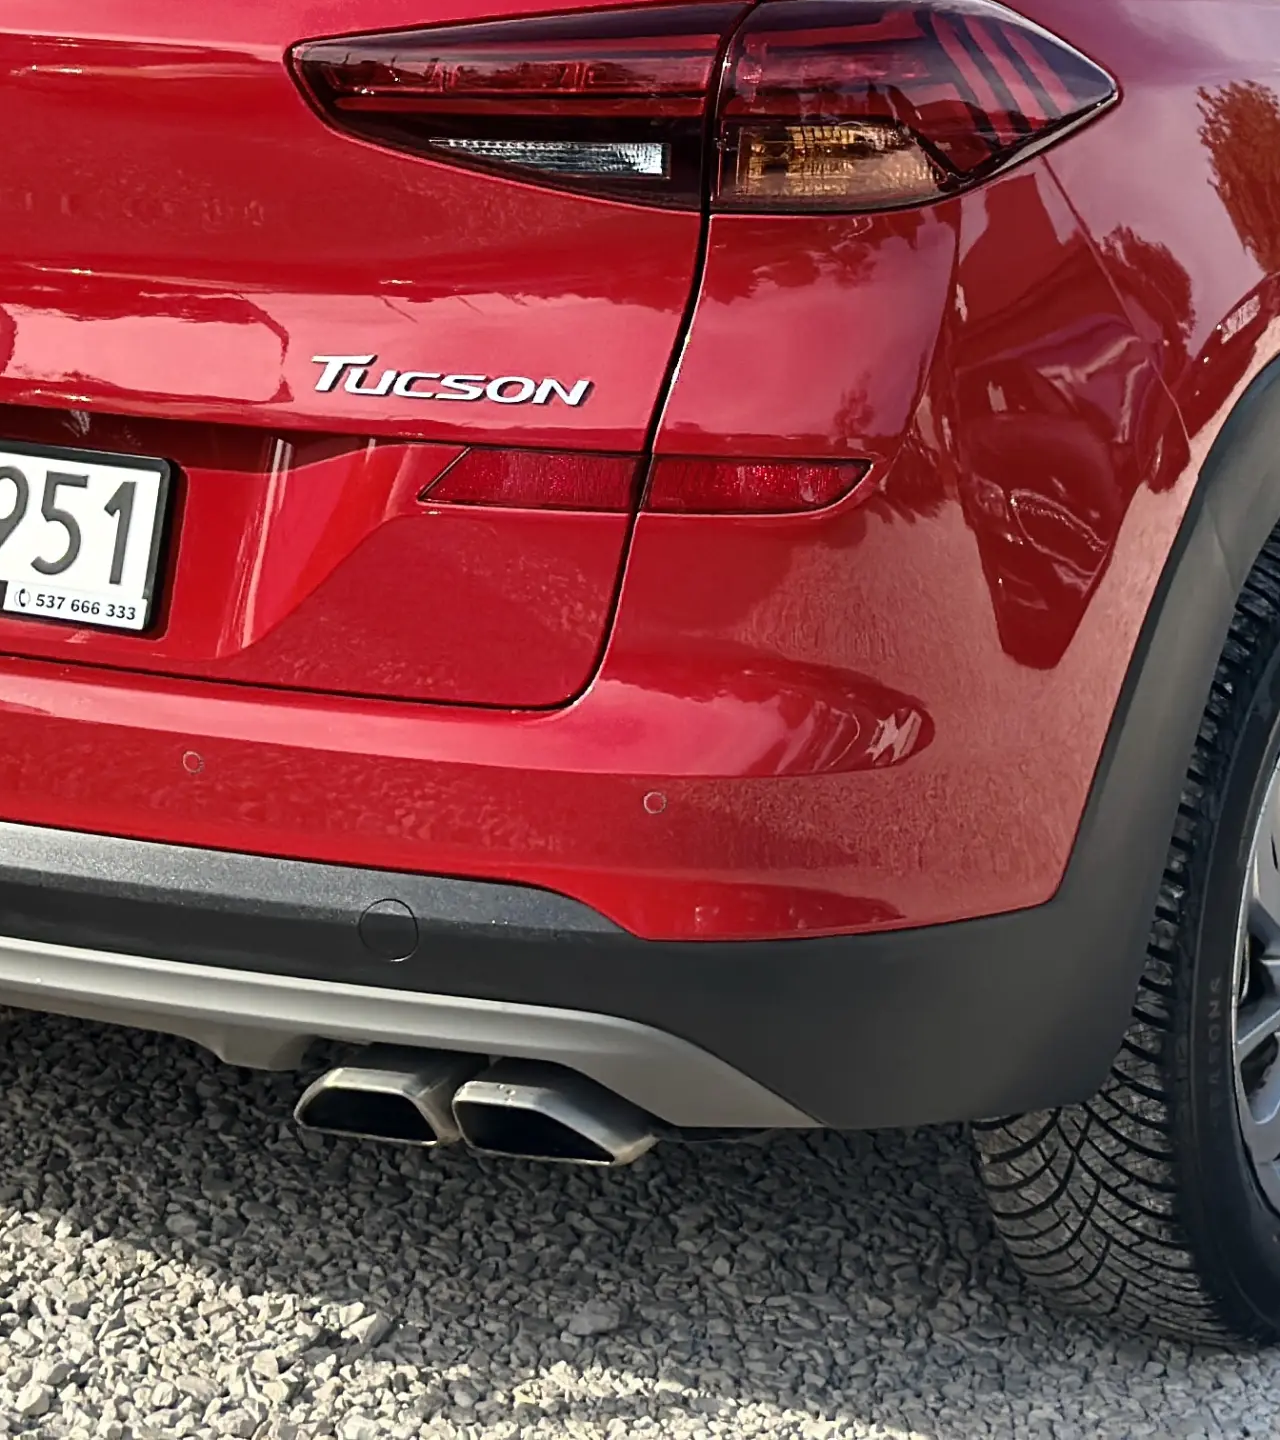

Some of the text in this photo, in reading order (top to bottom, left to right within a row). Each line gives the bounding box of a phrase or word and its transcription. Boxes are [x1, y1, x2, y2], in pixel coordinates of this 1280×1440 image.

[35, 593, 137, 621] 537 666 333
